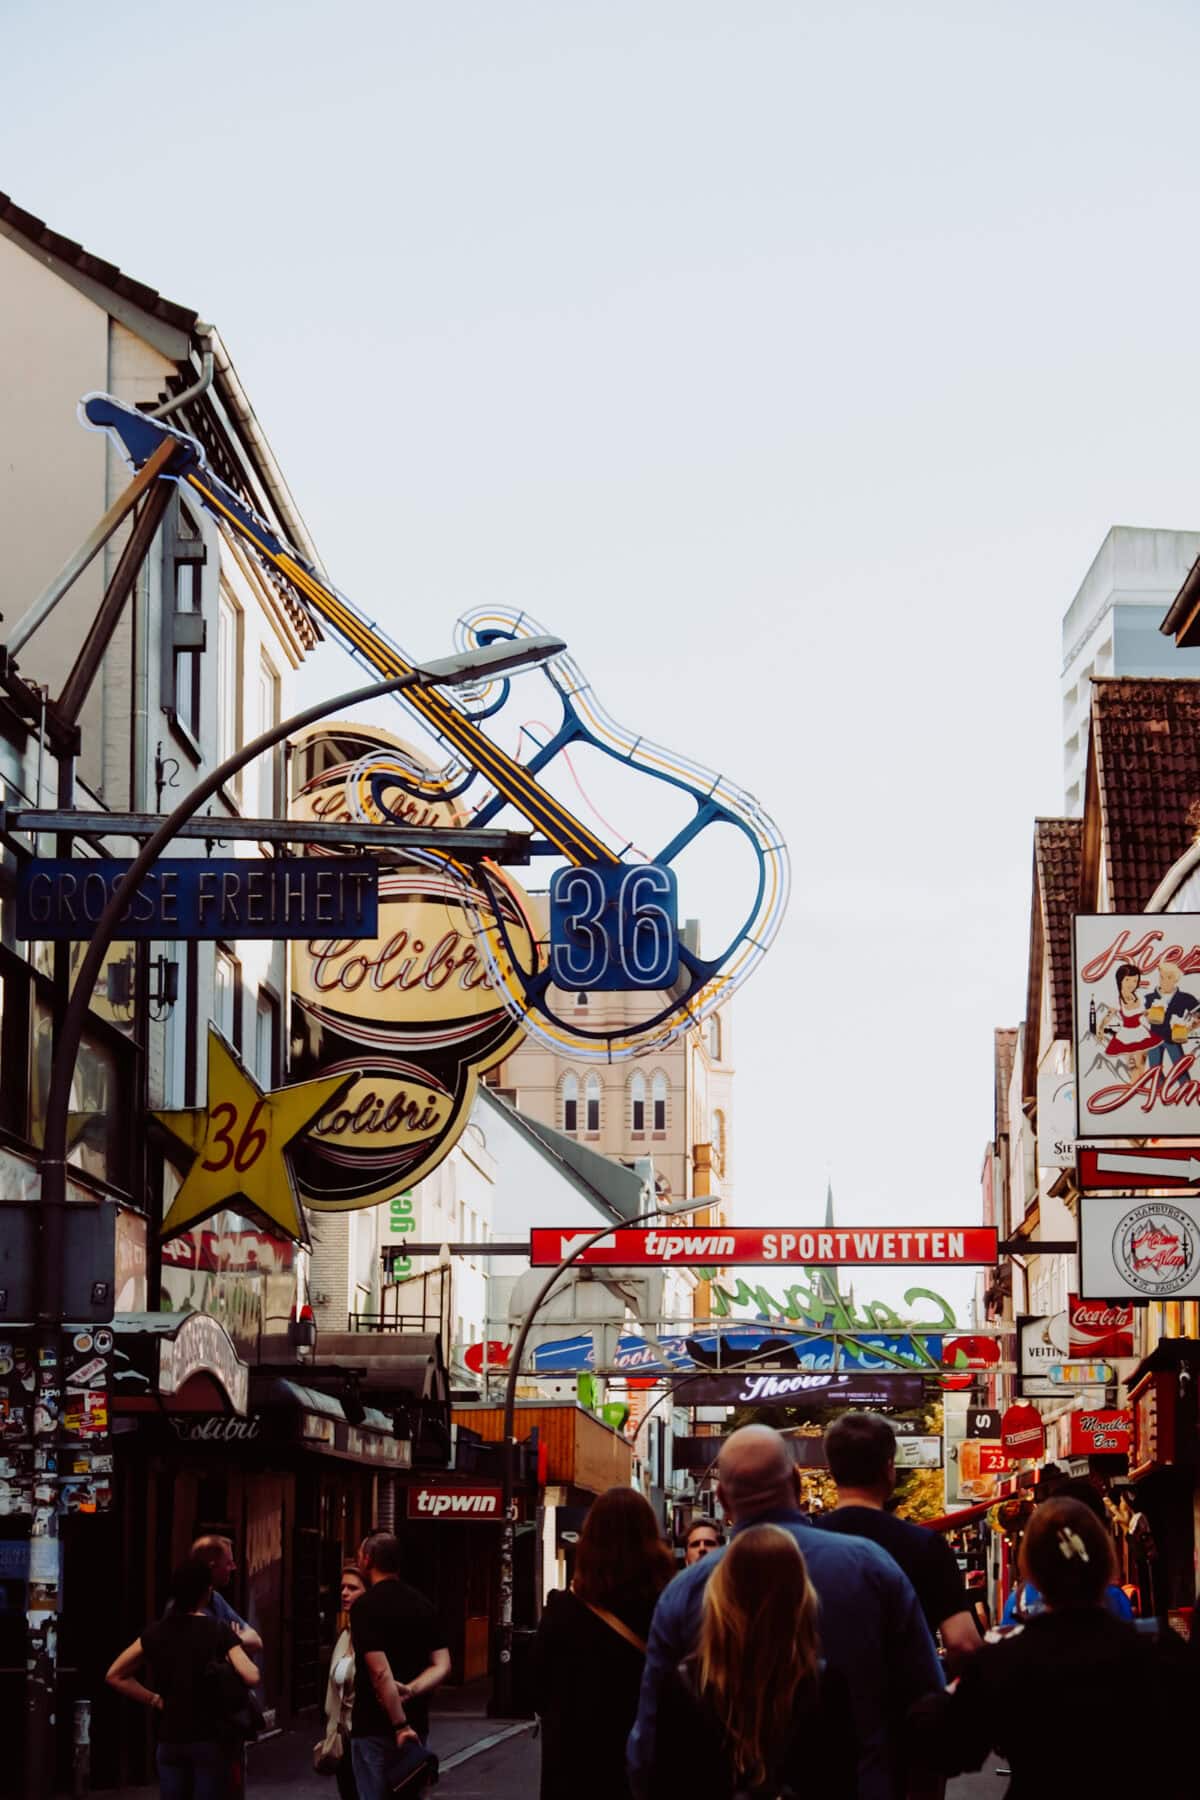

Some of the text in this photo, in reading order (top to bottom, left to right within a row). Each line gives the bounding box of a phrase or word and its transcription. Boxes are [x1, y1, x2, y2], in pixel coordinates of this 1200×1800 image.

[199, 872, 370, 923] FREIHEIT
[554, 866, 673, 986] 36
[201, 1101, 267, 1174] 36
[1133, 1205, 1181, 1220] HAMBURG
[644, 1231, 965, 1260] tipwin SPORTWETTEN
[1154, 1278, 1181, 1292] PAULI
[1080, 1416, 1131, 1432] Monika
[1093, 1434, 1118, 1449] Bar
[417, 1490, 497, 1516] tipwin
